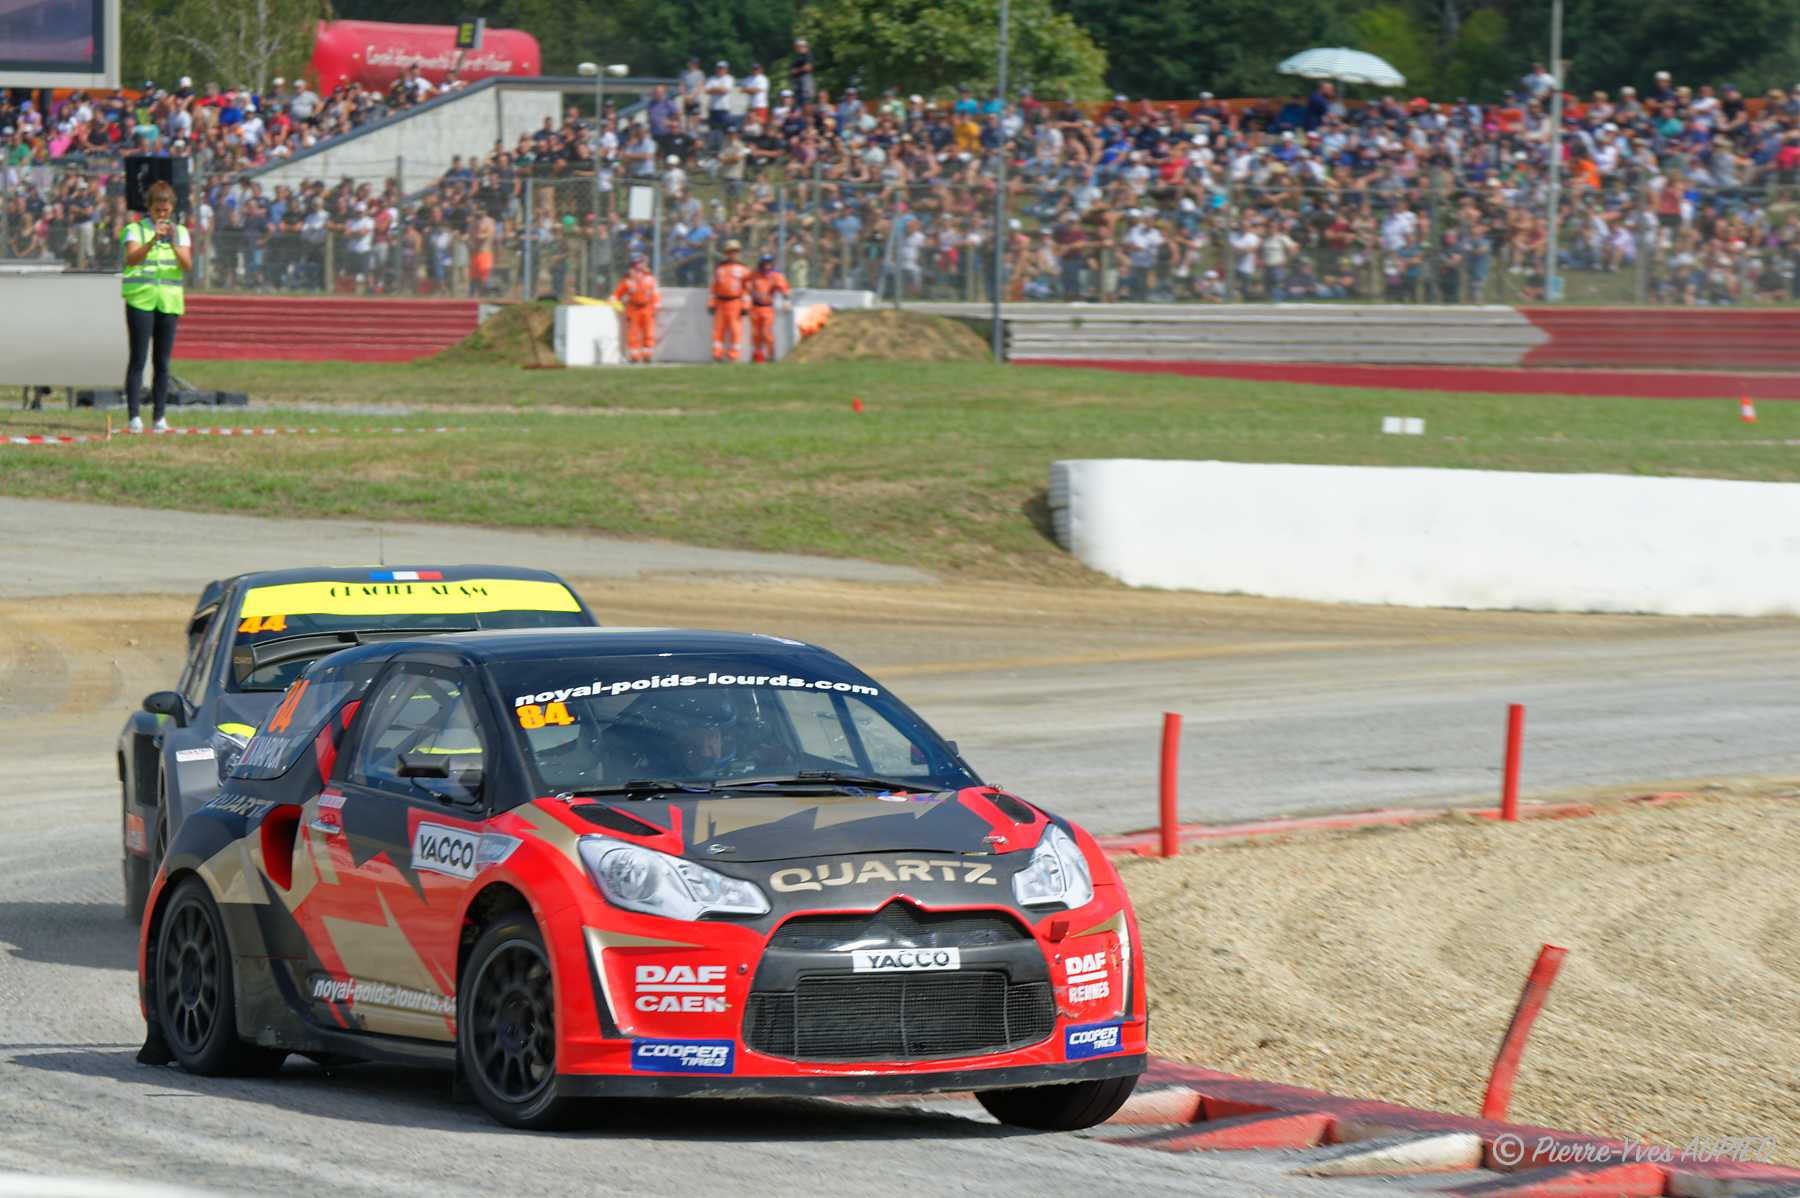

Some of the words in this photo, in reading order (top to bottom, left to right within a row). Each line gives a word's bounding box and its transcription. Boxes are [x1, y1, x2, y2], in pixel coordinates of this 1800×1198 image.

[238, 615, 288, 633] 44
[515, 673, 879, 706] noyal-poids-lourds.com
[515, 702, 576, 730] 84
[419, 834, 475, 870] YACCO
[769, 859, 998, 893] QUARTZ
[868, 951, 950, 969] YACCO
[1065, 952, 1106, 975] DAF
[635, 965, 728, 983] DAF
[635, 995, 727, 1013] CAEN
[1069, 1027, 1119, 1045] COOPER
[637, 1044, 730, 1058] COOPER
[680, 1057, 727, 1067] TIRES
